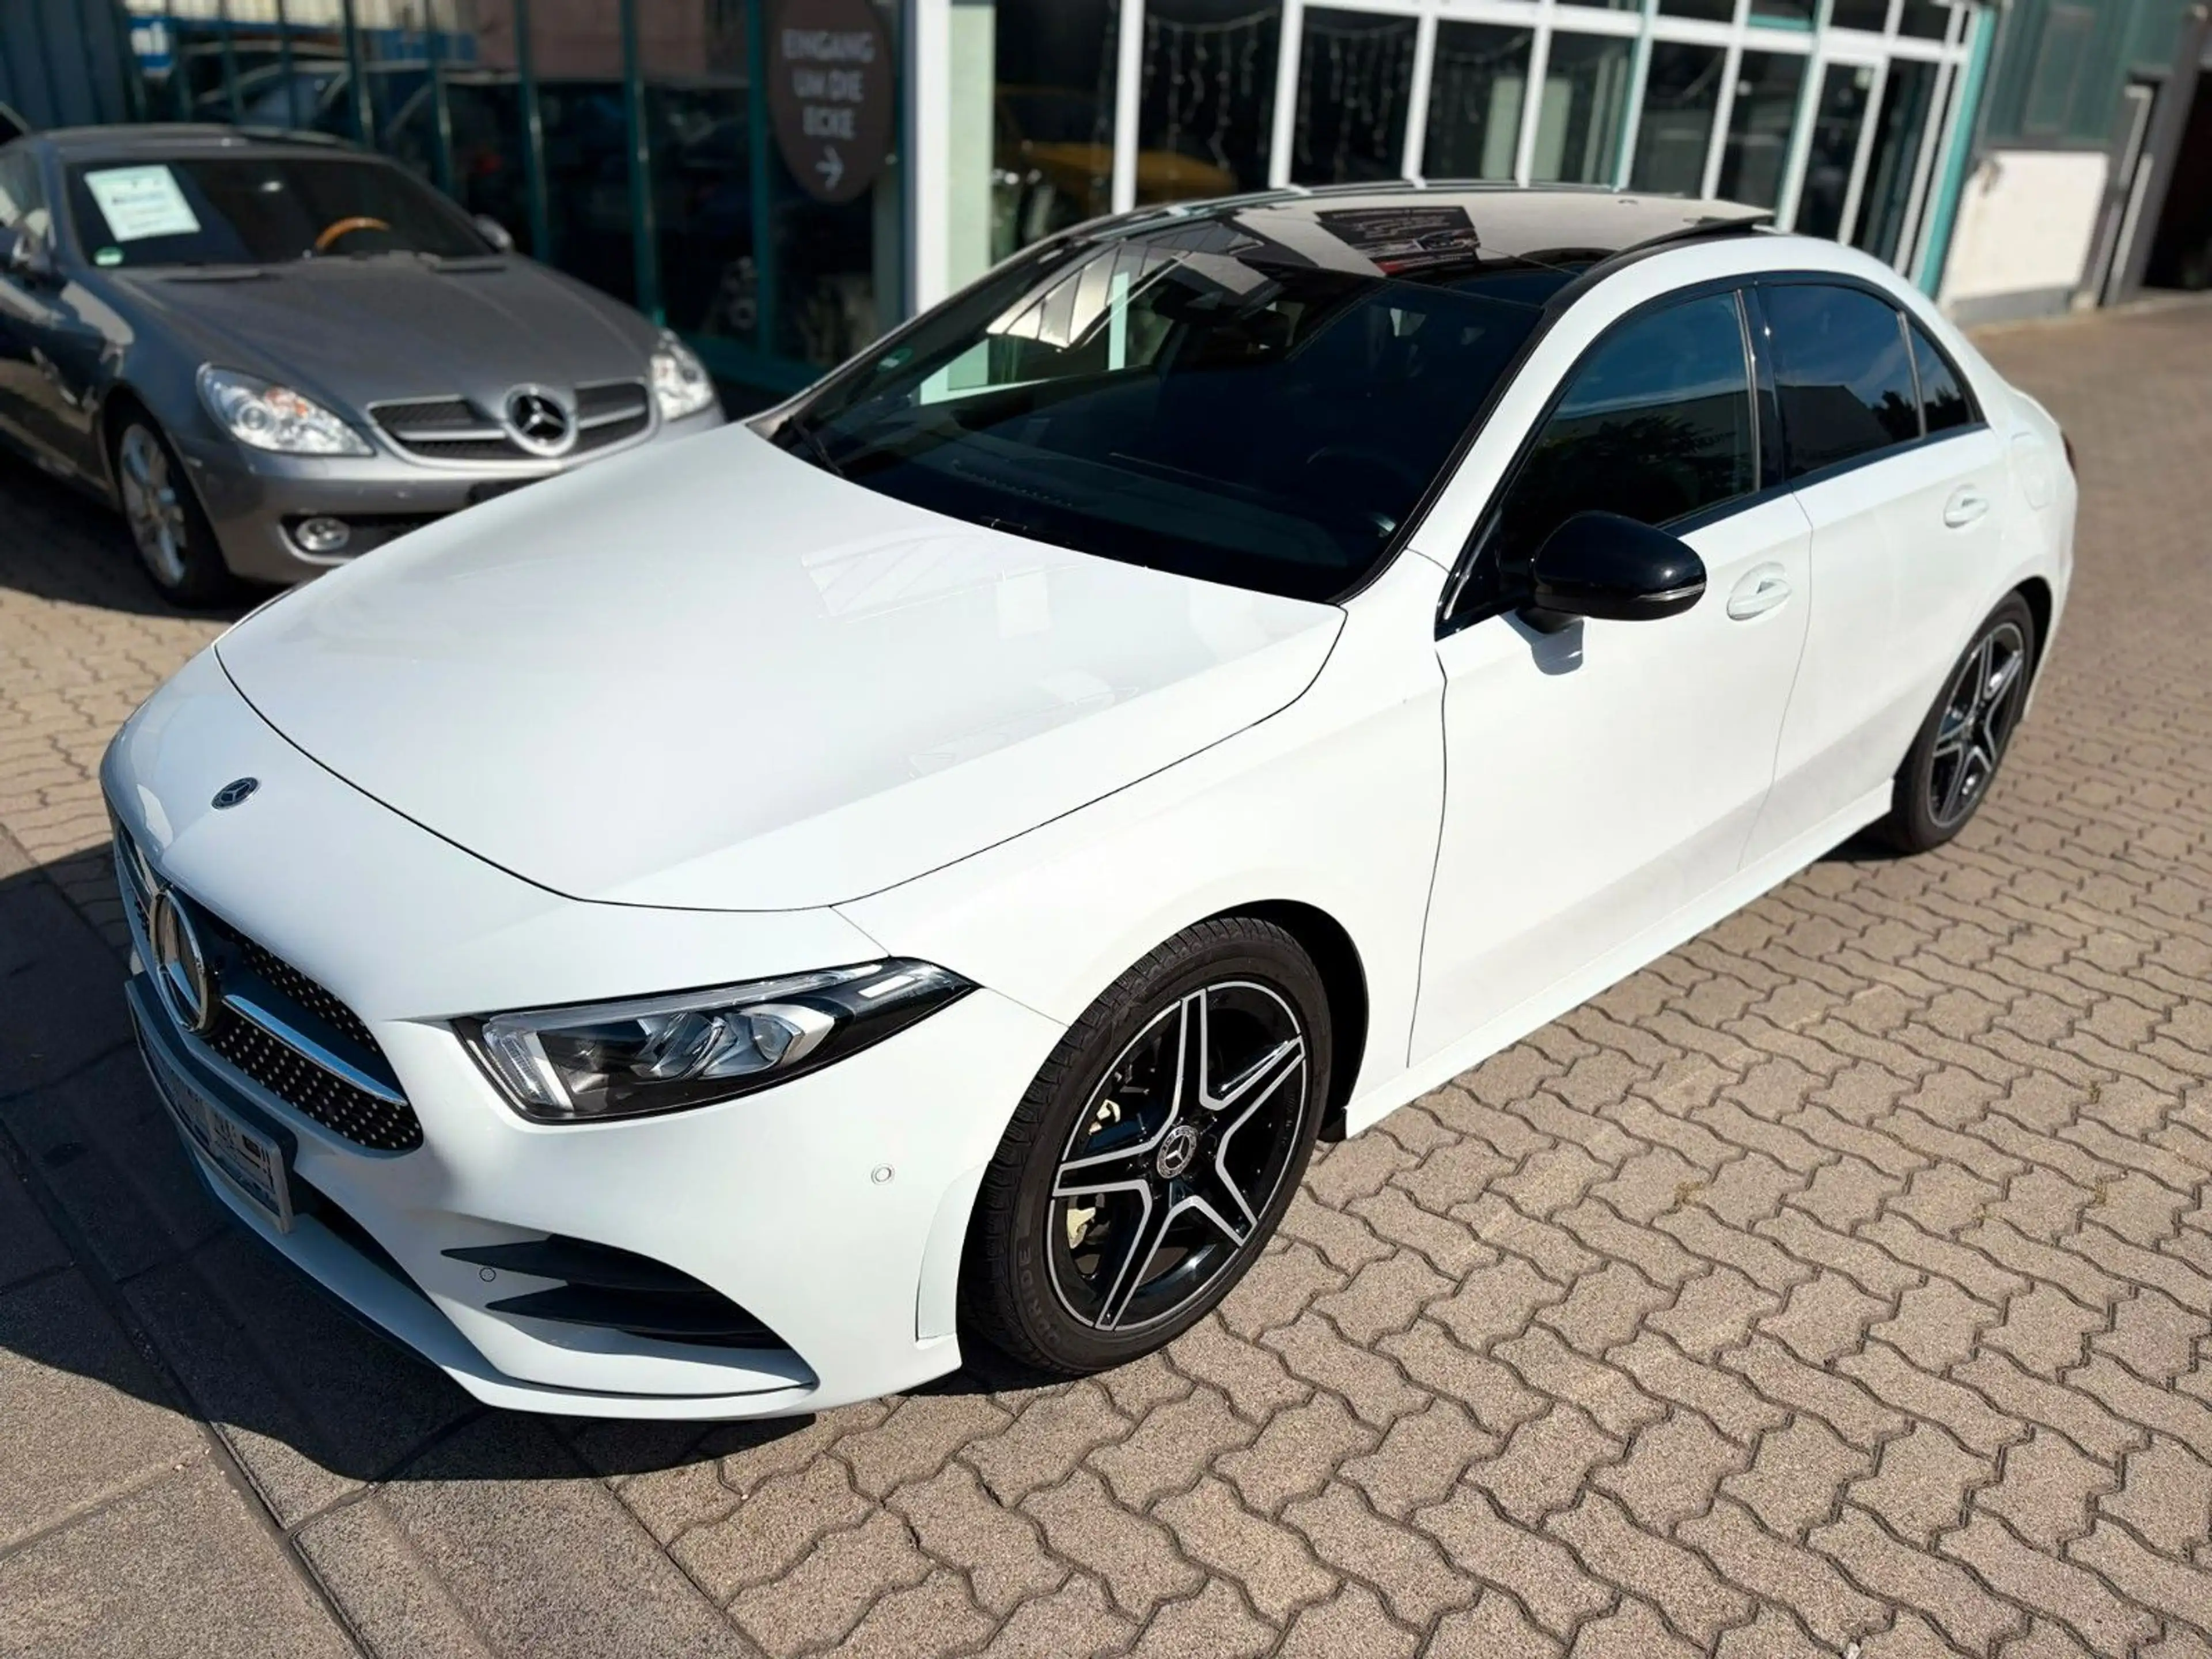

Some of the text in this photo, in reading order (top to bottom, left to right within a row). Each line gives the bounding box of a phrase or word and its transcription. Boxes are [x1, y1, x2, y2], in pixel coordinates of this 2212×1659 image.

[781, 29, 875, 62] EINGANG
[828, 68, 863, 103] DIE
[802, 104, 855, 141] ECKE
